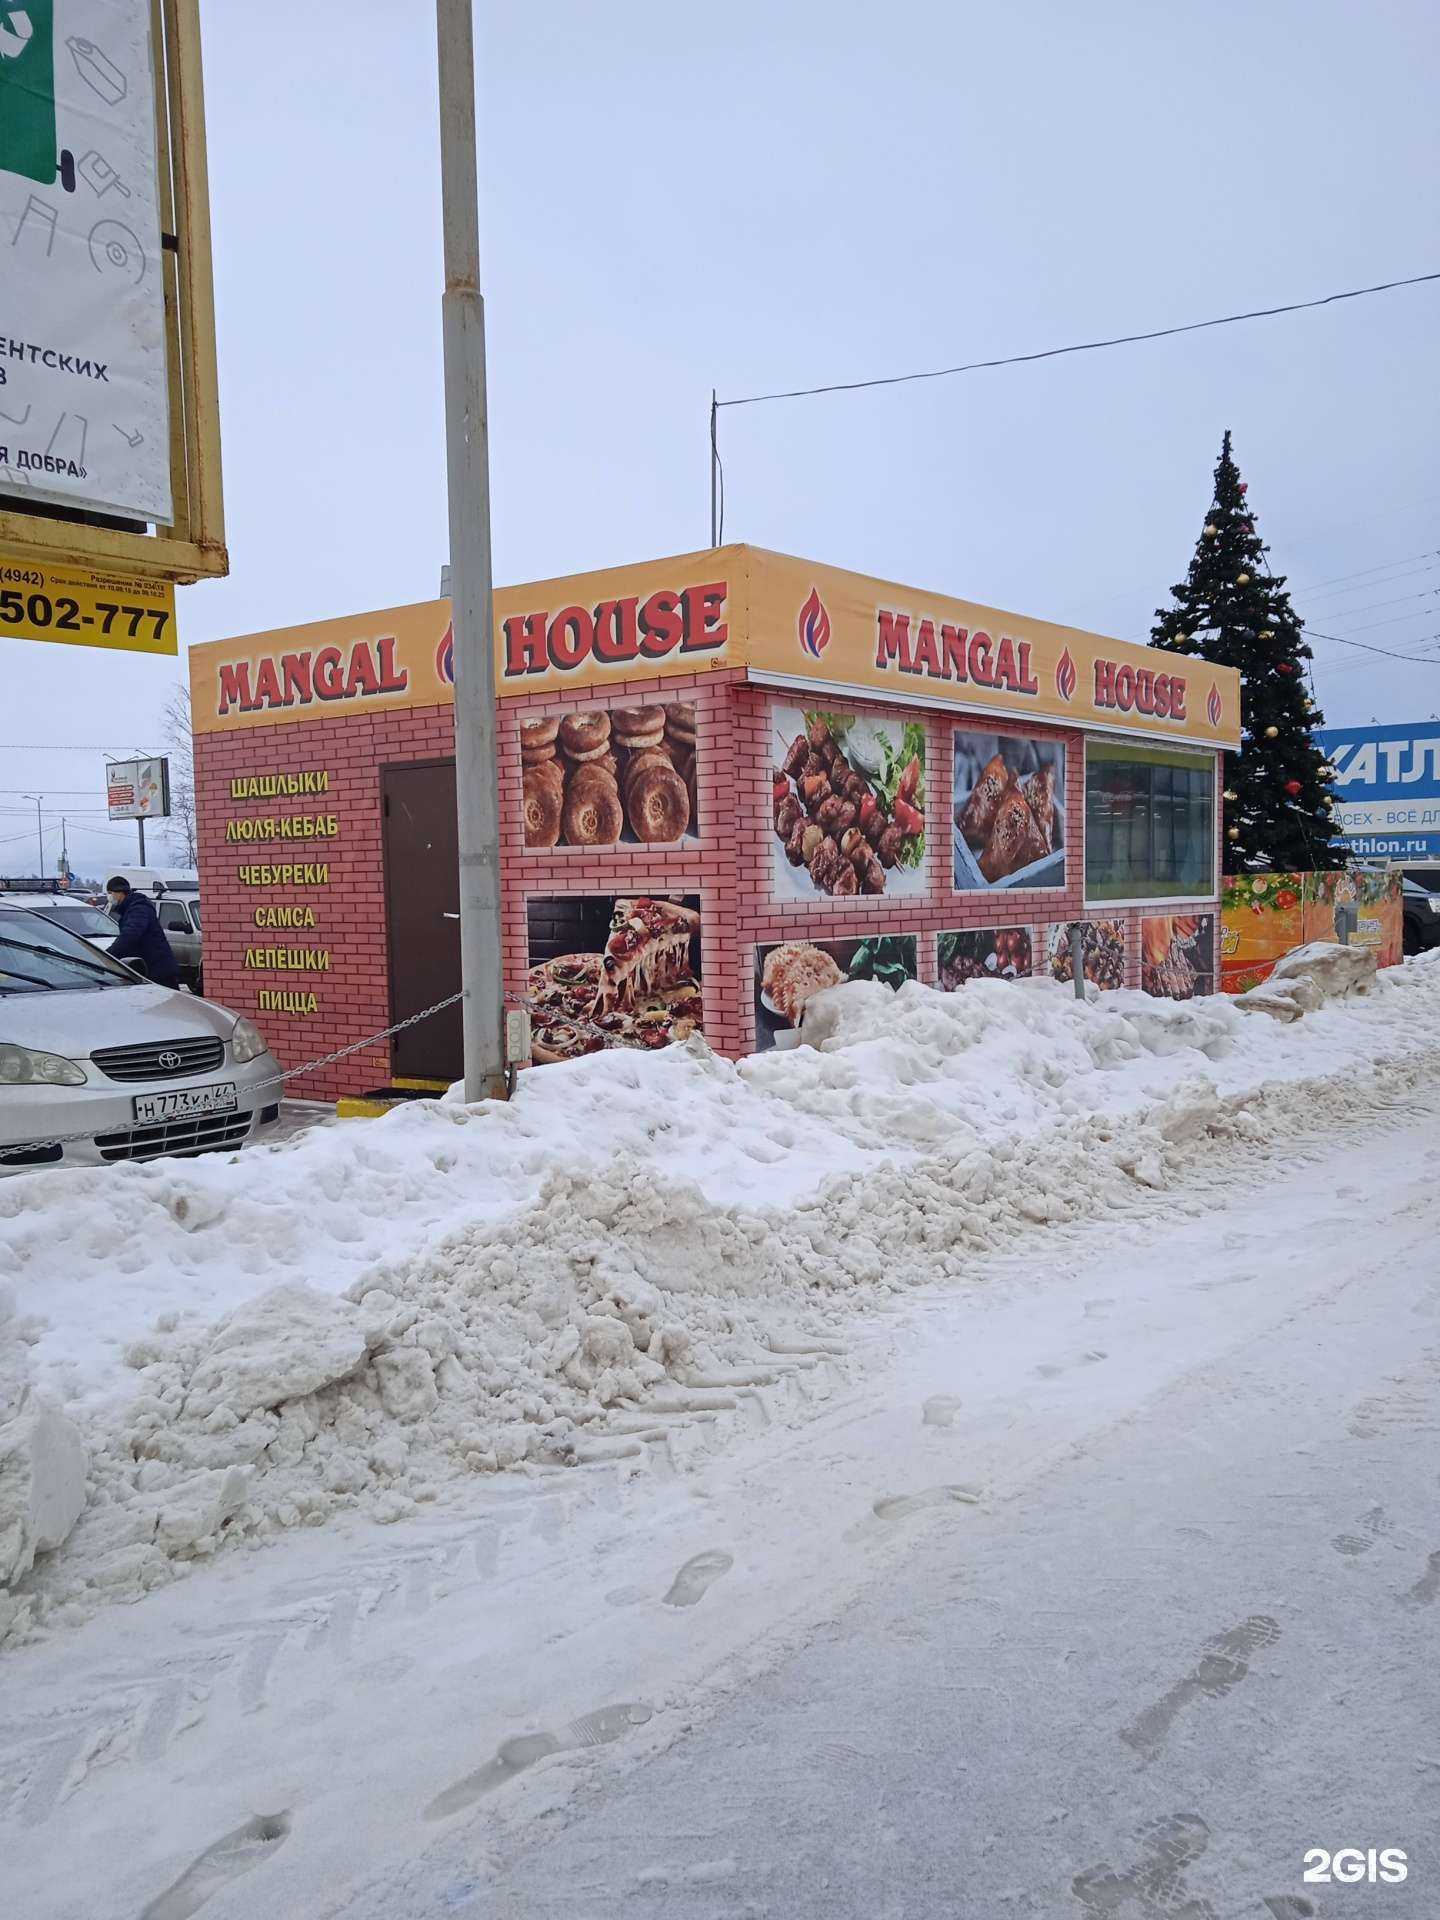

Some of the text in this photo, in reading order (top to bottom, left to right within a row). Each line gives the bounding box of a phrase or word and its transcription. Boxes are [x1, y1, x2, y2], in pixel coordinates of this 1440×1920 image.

[17, 450, 88, 479] ДОБРА»
[0, 567, 45, 588] (4942)
[0, 590, 170, 640] 502-777
[217, 581, 728, 715] MANGAL HOUSE
[876, 609, 1187, 721] MANGAL HOUSE
[231, 771, 329, 799] ШАШЛЫКИ
[226, 815, 338, 842] ЛЮЛЯ-КЕБАБ
[239, 863, 329, 886] ЧЕБУРЕКИ
[254, 907, 315, 928] САМСА
[244, 944, 330, 971] ЛЕПЁШКИ
[259, 990, 318, 1015] ПИЦЦА
